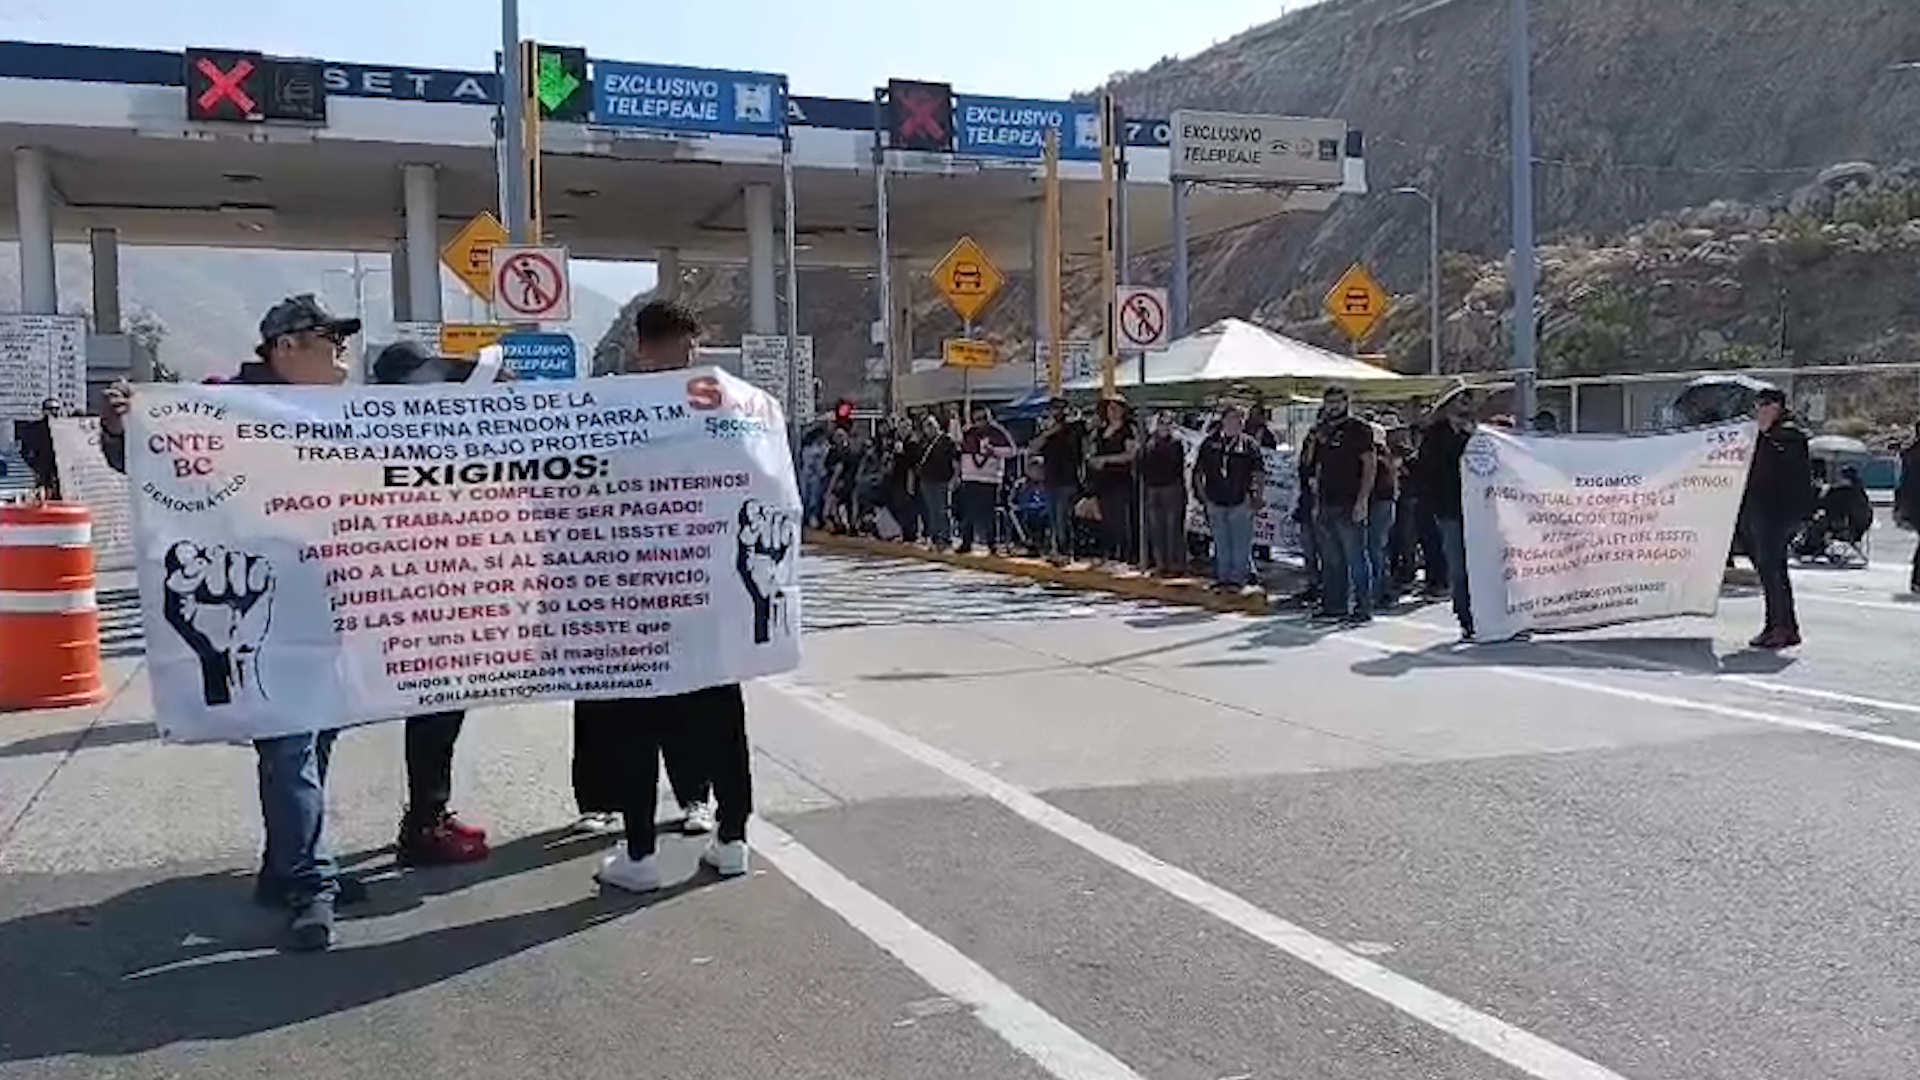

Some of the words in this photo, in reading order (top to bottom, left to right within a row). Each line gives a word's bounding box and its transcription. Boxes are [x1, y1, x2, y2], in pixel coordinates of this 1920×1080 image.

[604, 74, 718, 98] EXCLUSIVO
[606, 96, 718, 120] TELEPEAJE
[966, 106, 1063, 127] EXCLUSIVO
[966, 126, 1062, 148] TELEPEAE
[1183, 125, 1261, 143] EXCLUSIVO
[1184, 147, 1261, 164] TELEPEAJE
[504, 344, 569, 357] EXCLUSIVO
[344, 400, 395, 419] ¡LOS
[404, 396, 526, 416] MAESTROS
[534, 394, 562, 410] DE
[569, 392, 597, 407] LA
[477, 416, 569, 436] RENDON
[577, 408, 648, 428] PARRA
[651, 404, 691, 421] T.M.
[148, 434, 224, 454] CNTE
[296, 444, 458, 460] TRABAJAMOS
[466, 440, 524, 457] BAJO
[532, 430, 648, 452] PROTESTA!
[173, 457, 213, 477] BC
[384, 455, 609, 487] EXIGIMOS:
[265, 495, 330, 515] ¡PAGO
[340, 491, 441, 507] PUNTUAL
[451, 490, 462, 501] Y
[470, 485, 579, 500] COMPLETO
[587, 484, 599, 496] A
[607, 479, 642, 494] LOS
[383, 510, 509, 529] TRABAJADO
[518, 507, 570, 521] DEBE
[577, 504, 613, 519] SER
[621, 501, 703, 517] PAGADO!
[456, 533, 482, 547] DE
[491, 531, 515, 545] LA
[523, 528, 560, 543] LEY
[568, 525, 608, 540] DEL
[612, 523, 679, 538] ISSSTE
[326, 567, 362, 586] ¡NO
[370, 566, 384, 578] A
[392, 563, 418, 577] LA
[426, 558, 477, 574] UMA,
[511, 554, 535, 568] AL
[543, 550, 629, 566] SALARIO
[474, 579, 515, 594] POR
[523, 574, 577, 591] AÑOS
[584, 574, 609, 588] DE
[617, 570, 710, 588] SERVICIO,
[333, 618, 357, 632] 28
[365, 612, 405, 628] LAS
[412, 604, 510, 623] MUJERES
[518, 601, 532, 614] Y
[537, 600, 560, 614] 30
[567, 598, 604, 612] LOS
[612, 593, 710, 610] HOMBRES!
[384, 636, 421, 653] ¡Por
[429, 632, 465, 646] una
[472, 627, 510, 642] LEY
[518, 625, 555, 639] DEL
[562, 621, 629, 636] ISSSTE
[636, 621, 671, 636] que
[386, 648, 534, 675] REDIGNIFIQUE
[541, 648, 557, 661] al
[564, 642, 670, 660] magisterio!
[398, 677, 449, 691] UNIDOS
[456, 675, 463, 687] Y
